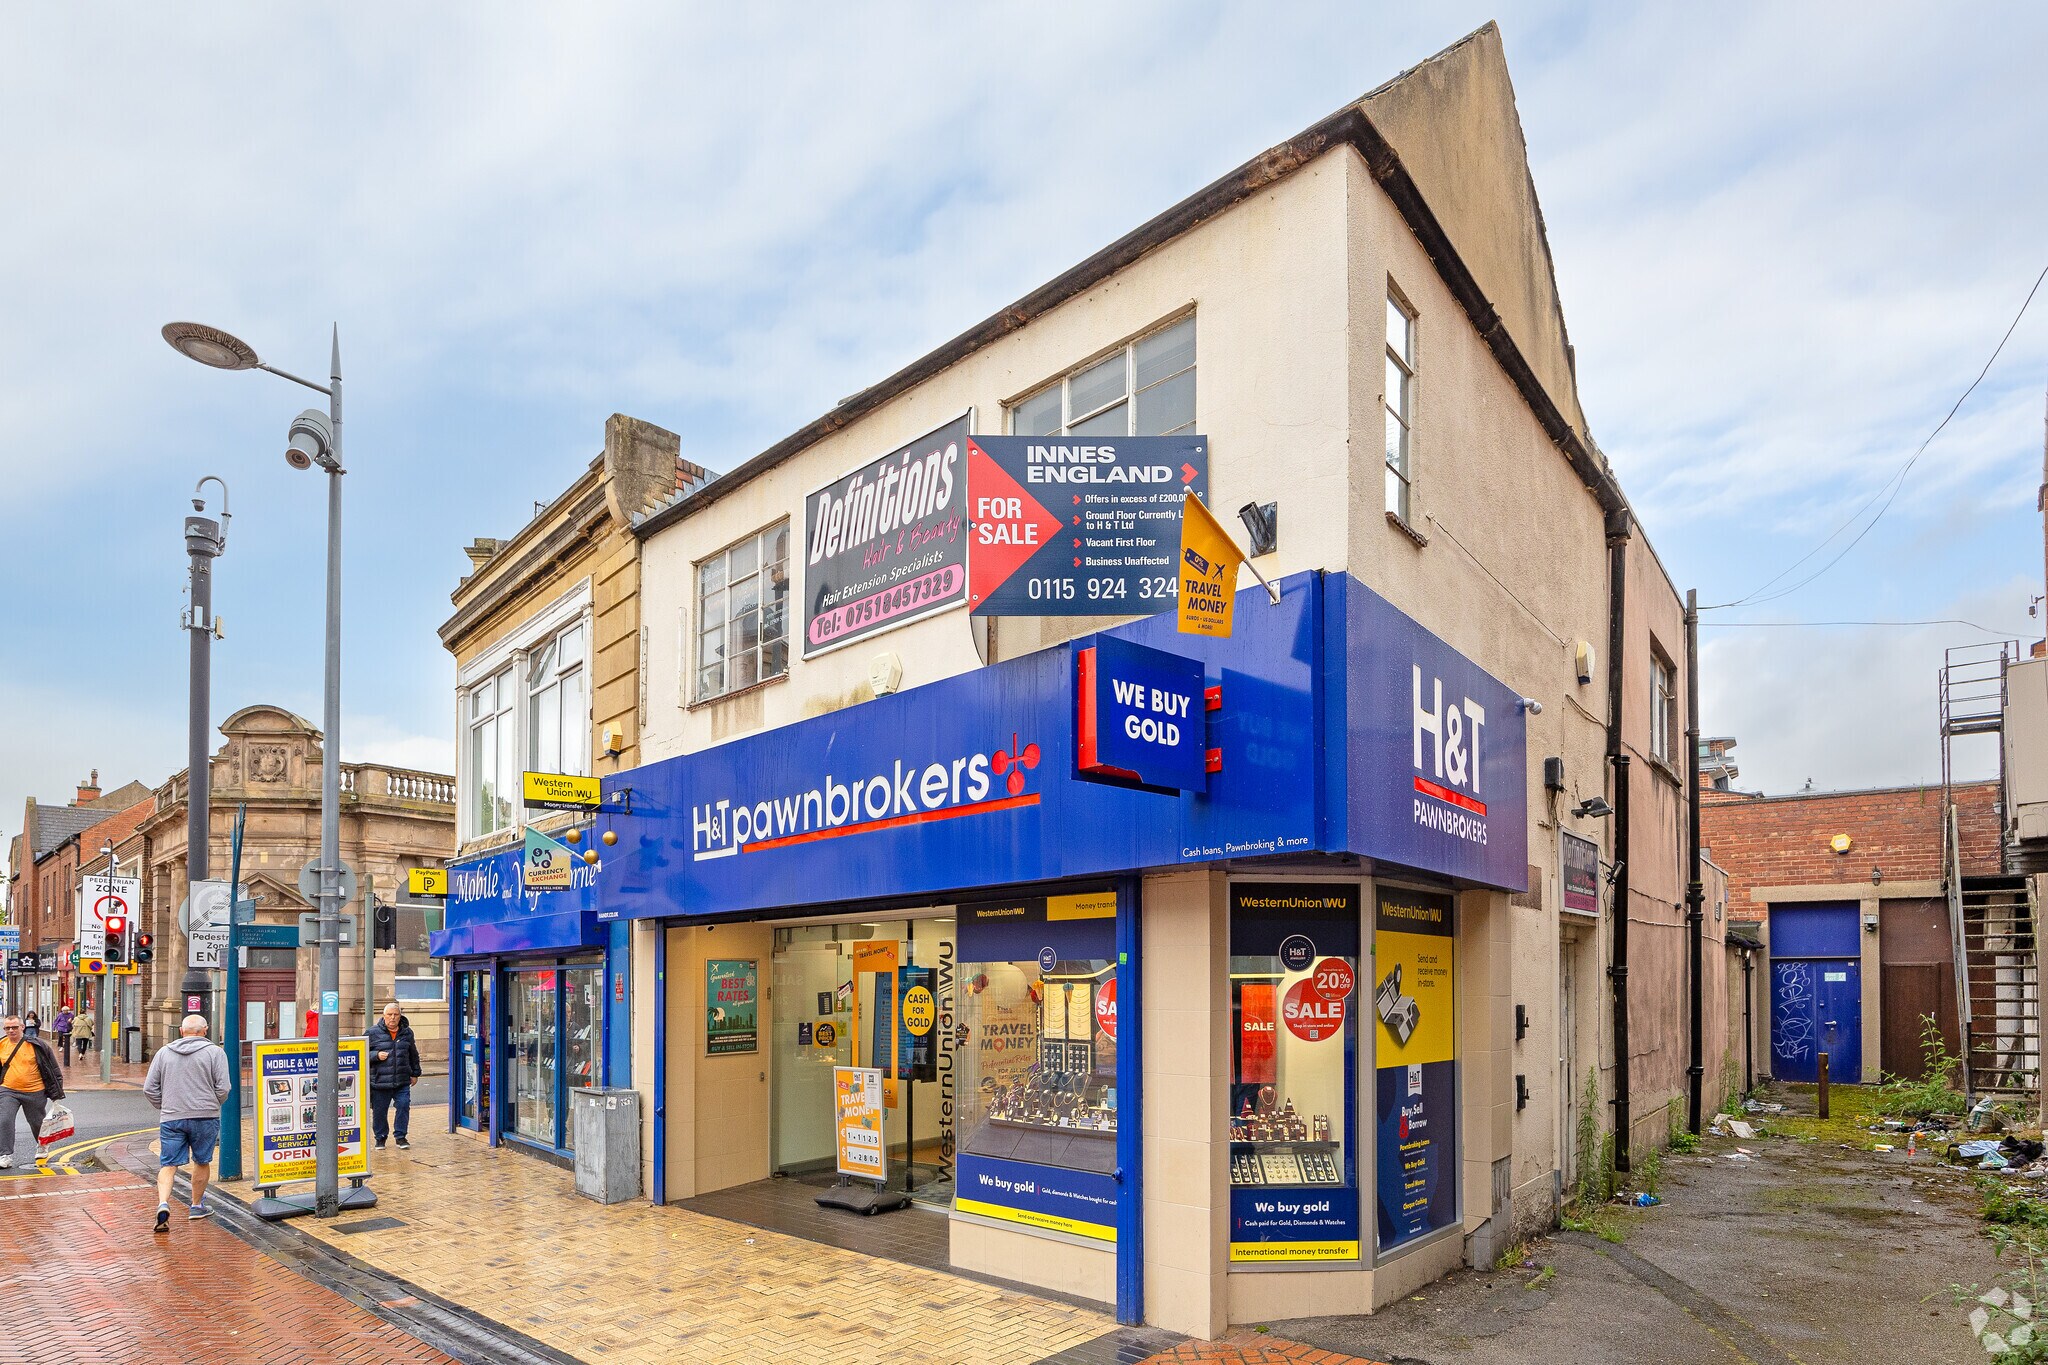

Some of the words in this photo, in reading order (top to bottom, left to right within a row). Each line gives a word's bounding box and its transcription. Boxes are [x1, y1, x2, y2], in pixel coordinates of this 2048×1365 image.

[1027, 446, 1116, 463] INNES
[1027, 466, 1173, 483] ENGLAND
[810, 442, 958, 566] Definitions
[1085, 494, 1109, 504] Offers
[1111, 495, 1118, 503] in
[1150, 494, 1157, 503] of
[978, 498, 1022, 518] FOR
[1086, 511, 1114, 520] Ground
[1116, 510, 1136, 520] Floor
[1139, 510, 1176, 520] Currently
[909, 506, 960, 552] Beauty
[1086, 521, 1094, 530] to
[1097, 521, 1103, 530] H
[1105, 521, 1112, 530] &
[1113, 521, 1120, 530] T
[1121, 520, 1134, 530] Ltd
[978, 524, 1038, 545] SALE
[1086, 538, 1113, 547] Vacant
[1116, 538, 1134, 547] First
[1136, 538, 1156, 547] Floor
[1086, 556, 1122, 566] Business
[1124, 556, 1170, 566] Unaffected
[822, 592, 842, 608] Hair
[842, 575, 887, 600] Extension
[890, 550, 944, 582] Specialists
[1028, 578, 1075, 600] 0115
[1087, 577, 1127, 599] 924
[1138, 576, 1179, 598] 324
[1186, 580, 1222, 597] TRAVEL
[817, 615, 841, 638] Tel:
[846, 569, 954, 628] 07518457329
[1188, 597, 1227, 614] MONEY
[1112, 678, 1145, 709] WE
[1151, 688, 1191, 718] BUY
[1124, 715, 1181, 747] GOLD
[1412, 662, 1485, 795] H&T
[534, 777, 573, 788] Western
[546, 788, 573, 797] Union
[576, 790, 592, 799] WU
[732, 753, 990, 845] pawnbrokers
[1413, 799, 1487, 846] PAWNBROKERS
[1182, 848, 1200, 858] Cash
[1202, 846, 1224, 855] loans,
[1226, 839, 1274, 852] Pawnbroking
[1277, 836, 1284, 847] &
[1286, 837, 1308, 846] more
[528, 868, 564, 877] CURRENCY
[532, 873, 567, 882] EXCHANGE
[455, 860, 498, 905] Mobile
[96, 884, 128, 894] ZONE
[1076, 902, 1095, 910] Money
[1290, 948, 1306, 956] H&T
[722, 978, 746, 990] BEST
[717, 990, 749, 1002] RATES
[908, 994, 930, 1004] CASH
[912, 1006, 924, 1014] FOR
[1285, 1002, 1342, 1018] SALE
[907, 1017, 930, 1028] GOLD
[1244, 1022, 1274, 1032] SALE
[982, 1024, 1034, 1036] TRAVEL
[981, 1036, 1034, 1053] MONEY
[266, 1058, 296, 1070] MOBILE
[298, 1058, 304, 1068] &
[841, 1092, 865, 1106] TRAVE
[1408, 1119, 1428, 1130] Borrow
[278, 1140, 309, 1148] SERVICE
[272, 1149, 310, 1160] OPEN
[979, 1174, 994, 1186] We
[996, 1176, 1012, 1192] buy
[1014, 1180, 1034, 1194] gold
[1255, 1202, 1274, 1212] We
[1278, 1202, 1300, 1214] buy
[1303, 1200, 1330, 1214] gold
[1258, 1220, 1270, 1228] paid
[1236, 1248, 1288, 1256] International
[1290, 1248, 1316, 1256] money
[1318, 1247, 1349, 1255] transfer
